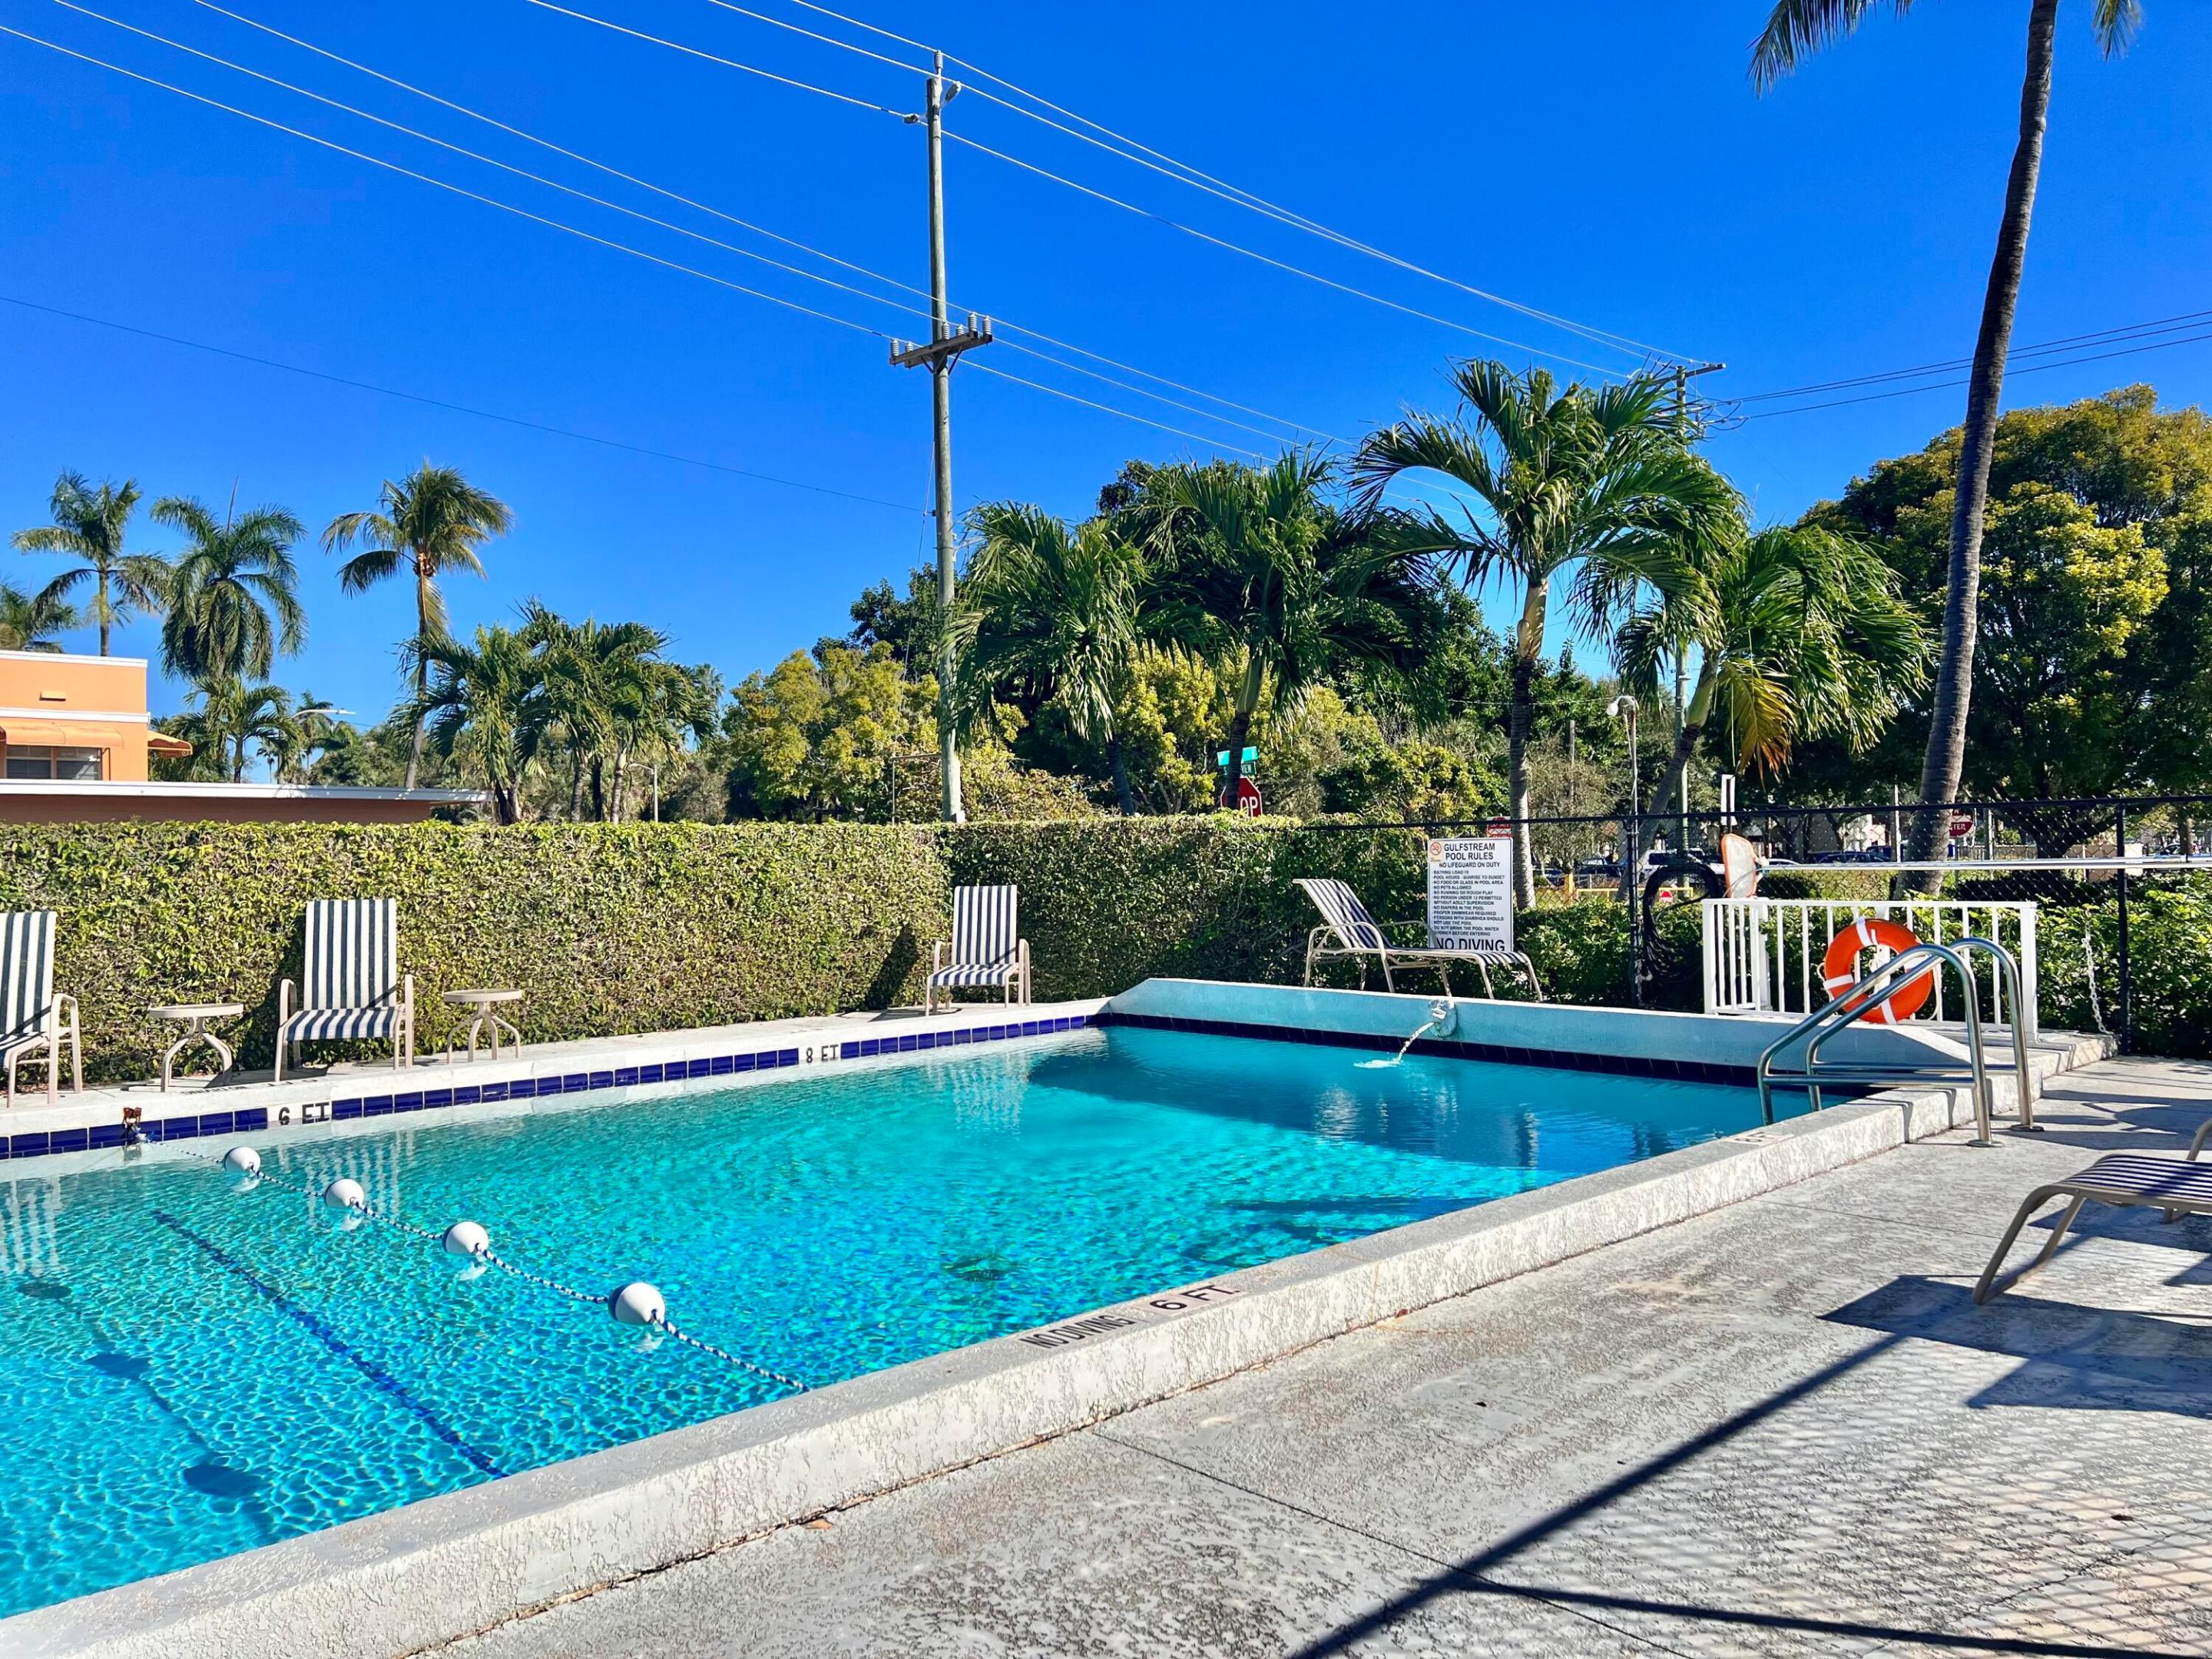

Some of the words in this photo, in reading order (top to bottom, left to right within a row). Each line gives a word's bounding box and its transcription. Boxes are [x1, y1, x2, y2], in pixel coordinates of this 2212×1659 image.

[1444, 843, 1495, 852] GULFSTREAM
[1436, 938, 1455, 949] NO
[1459, 939, 1505, 952] DIVING
[806, 1046, 813, 1064] 8
[278, 1106, 290, 1126] 6
[1019, 1333, 1070, 1349] NO
[1055, 1314, 1137, 1341] DIVING
[1149, 1299, 1188, 1311] 6
[1179, 1284, 1240, 1302] FT.
